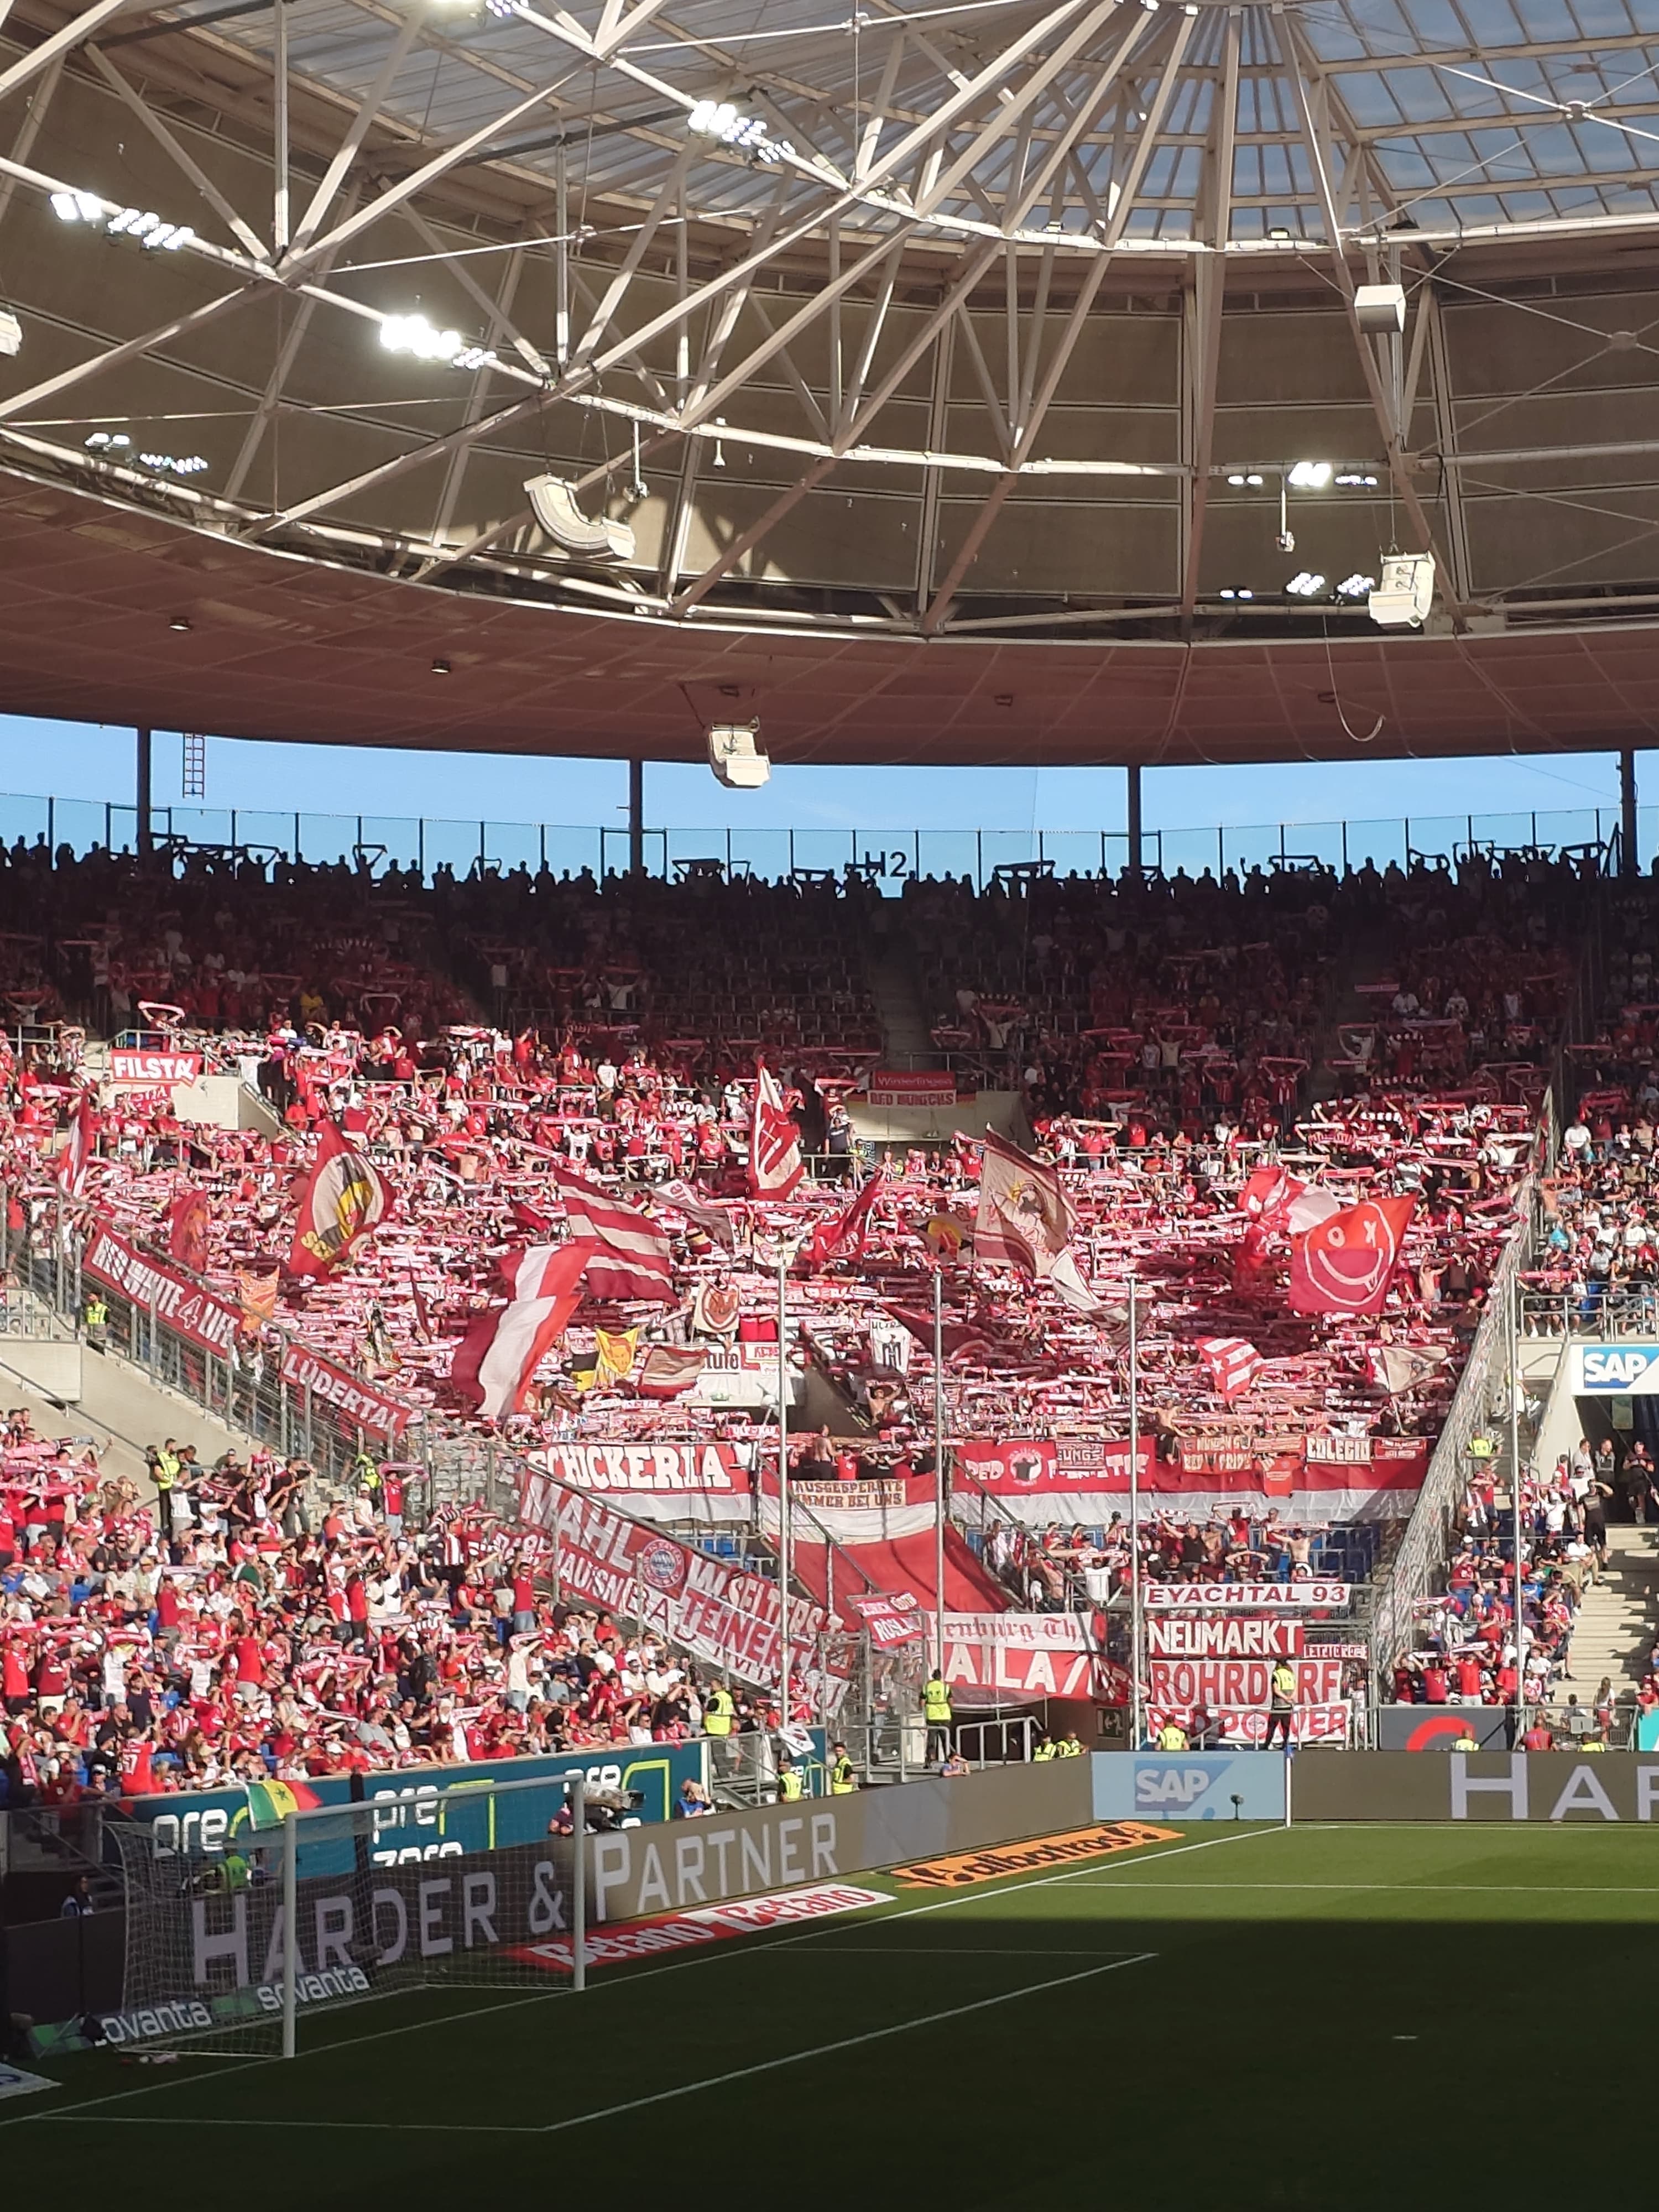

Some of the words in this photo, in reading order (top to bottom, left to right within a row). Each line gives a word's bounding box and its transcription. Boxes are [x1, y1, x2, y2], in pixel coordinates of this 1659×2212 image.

[865, 851, 907, 877] H2
[178, 1294, 204, 1330] 4
[1584, 1353, 1647, 1383] SAP
[527, 1446, 731, 1489] SCHICKERIA
[728, 1576, 823, 1641] SELTRS
[1147, 1586, 1301, 1603] EYACHTAL
[1312, 1585, 1346, 1603] 93
[1149, 1619, 1304, 1655] NEUMARKT
[1151, 1662, 1340, 1705] ROHRDRF
[1136, 1769, 1210, 1802] SAP
[962, 1834, 1132, 1875] albatros
[192, 1871, 499, 1987] HARDER
[529, 1861, 566, 1934] &
[593, 1812, 839, 1922] PARTNER
[709, 1888, 876, 1926] Betano
[528, 1923, 715, 1967] Betano
[95, 1999, 212, 2046] ovanta
